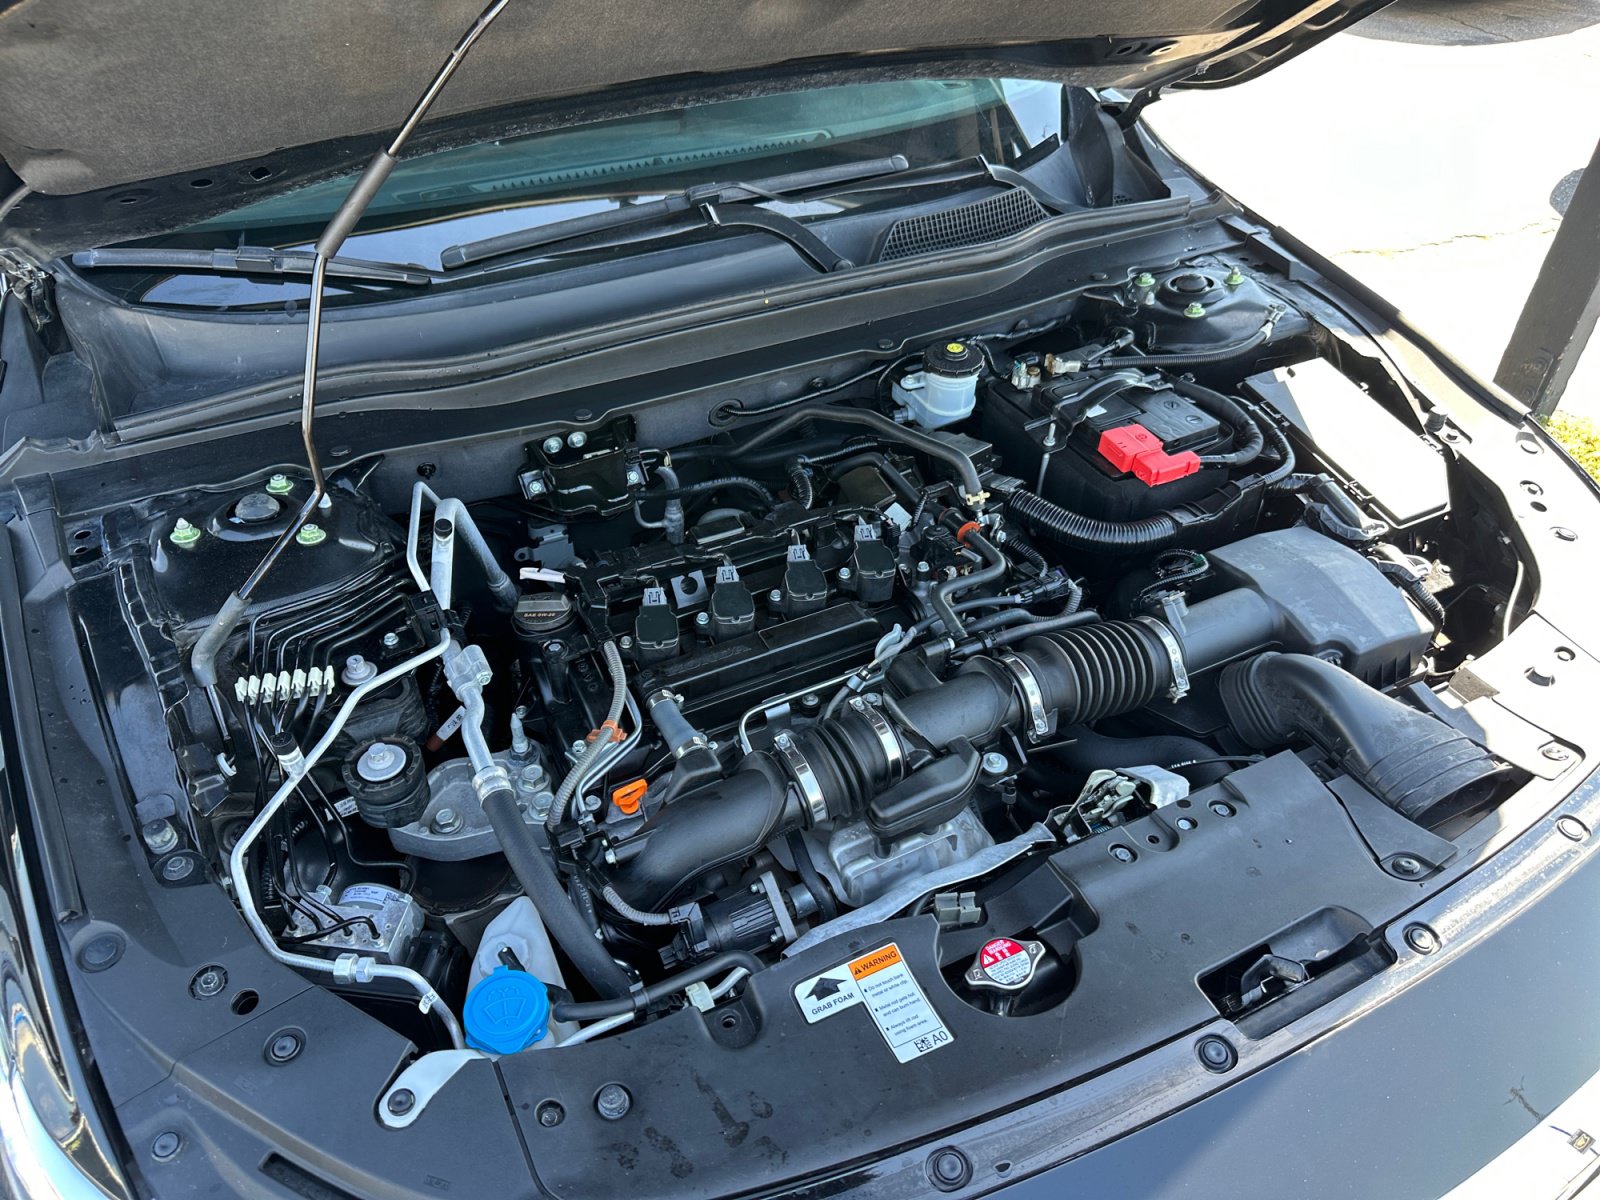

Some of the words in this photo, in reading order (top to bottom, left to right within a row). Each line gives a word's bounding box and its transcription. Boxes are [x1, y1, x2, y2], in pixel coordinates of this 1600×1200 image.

[860, 950, 897, 972] WARNING
[811, 1000, 833, 1015] GRAB
[833, 992, 854, 1006] FOAM
[933, 1030, 949, 1046] A0
